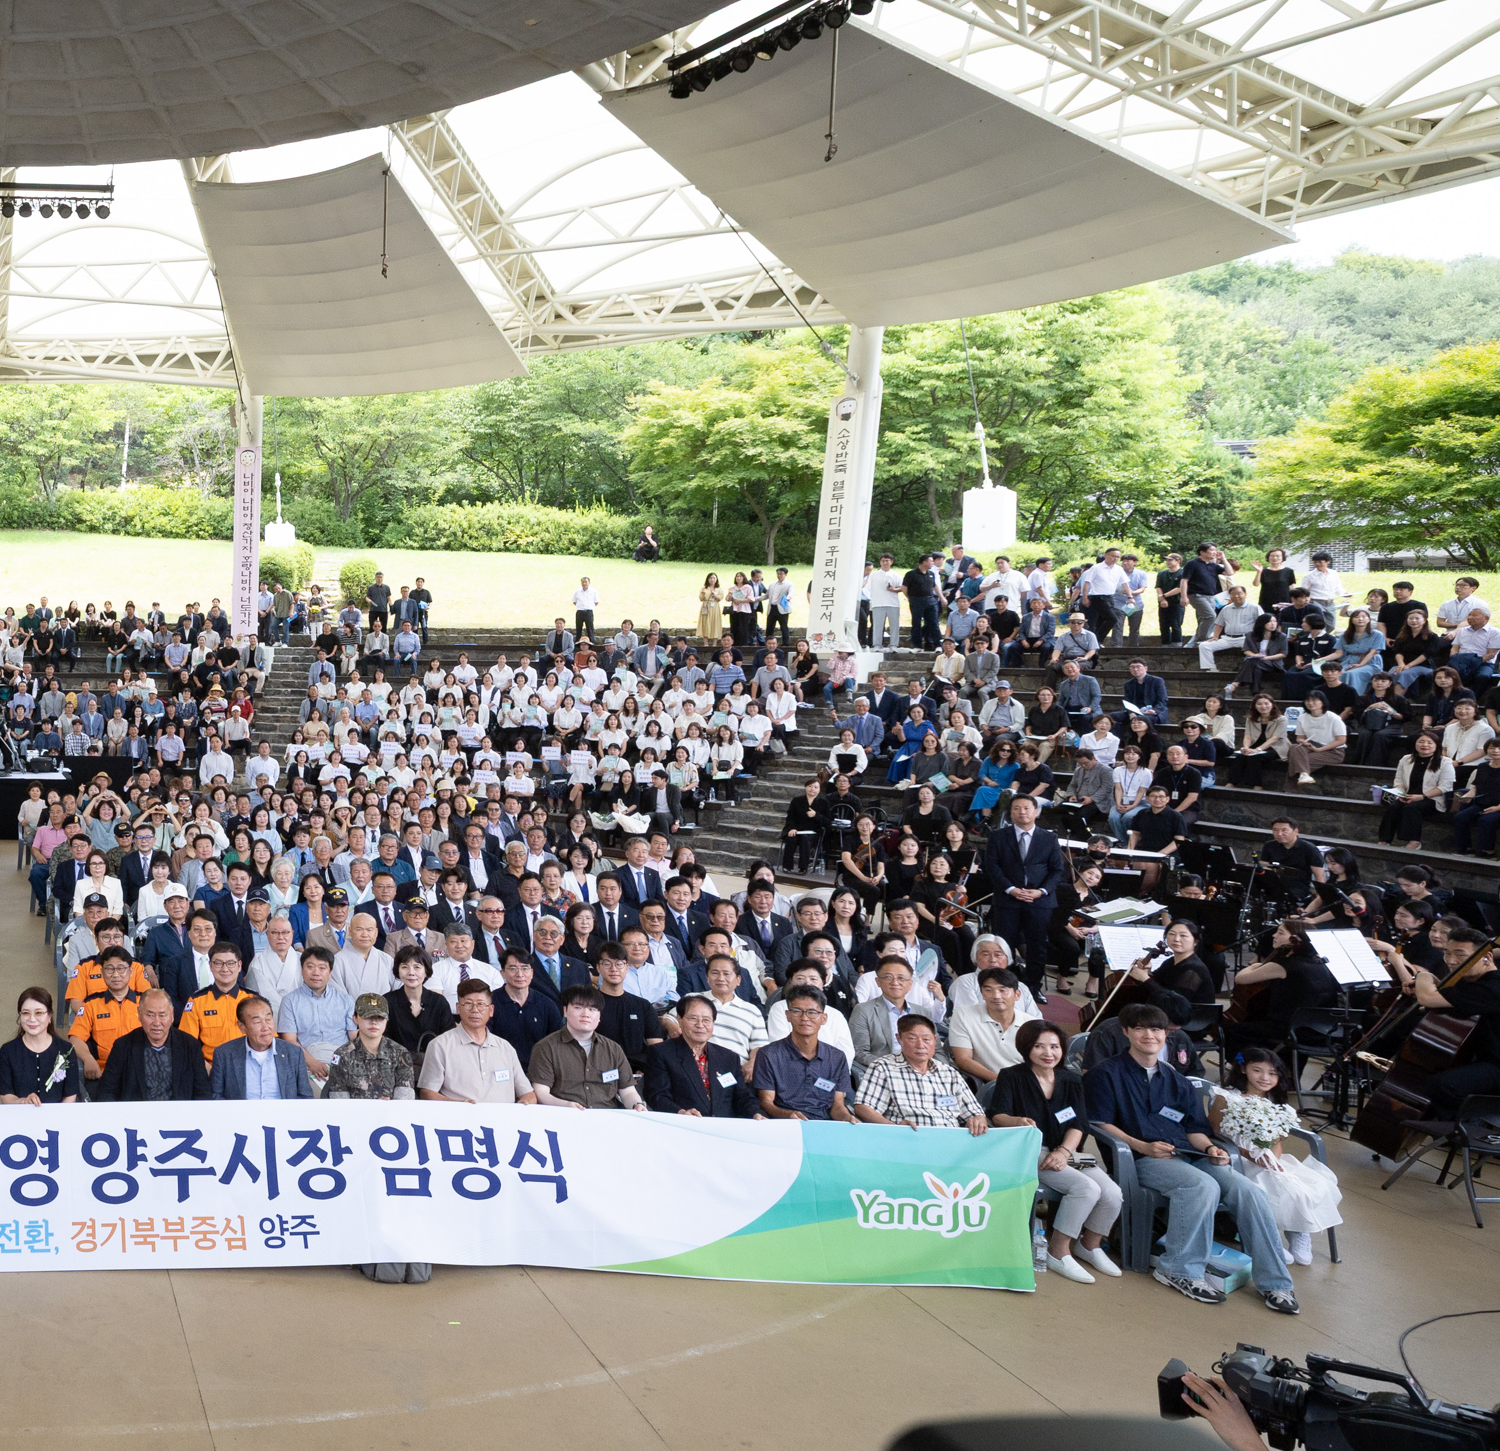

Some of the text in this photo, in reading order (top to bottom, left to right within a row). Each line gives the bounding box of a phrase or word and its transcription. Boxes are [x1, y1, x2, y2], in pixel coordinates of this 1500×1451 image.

[243, 472, 255, 495] 나비야
[242, 497, 254, 520] 나비야
[827, 479, 845, 541] 열두마디를
[240, 555, 253, 594] 호랑나비야
[239, 596, 252, 628] 너도가자
[819, 586, 836, 623] 잡구서
[80, 1123, 354, 1205] 양주시장
[368, 1123, 569, 1205] 임명식
[70, 1214, 247, 1253] 경기북부중심
[258, 1213, 321, 1250] 양주
